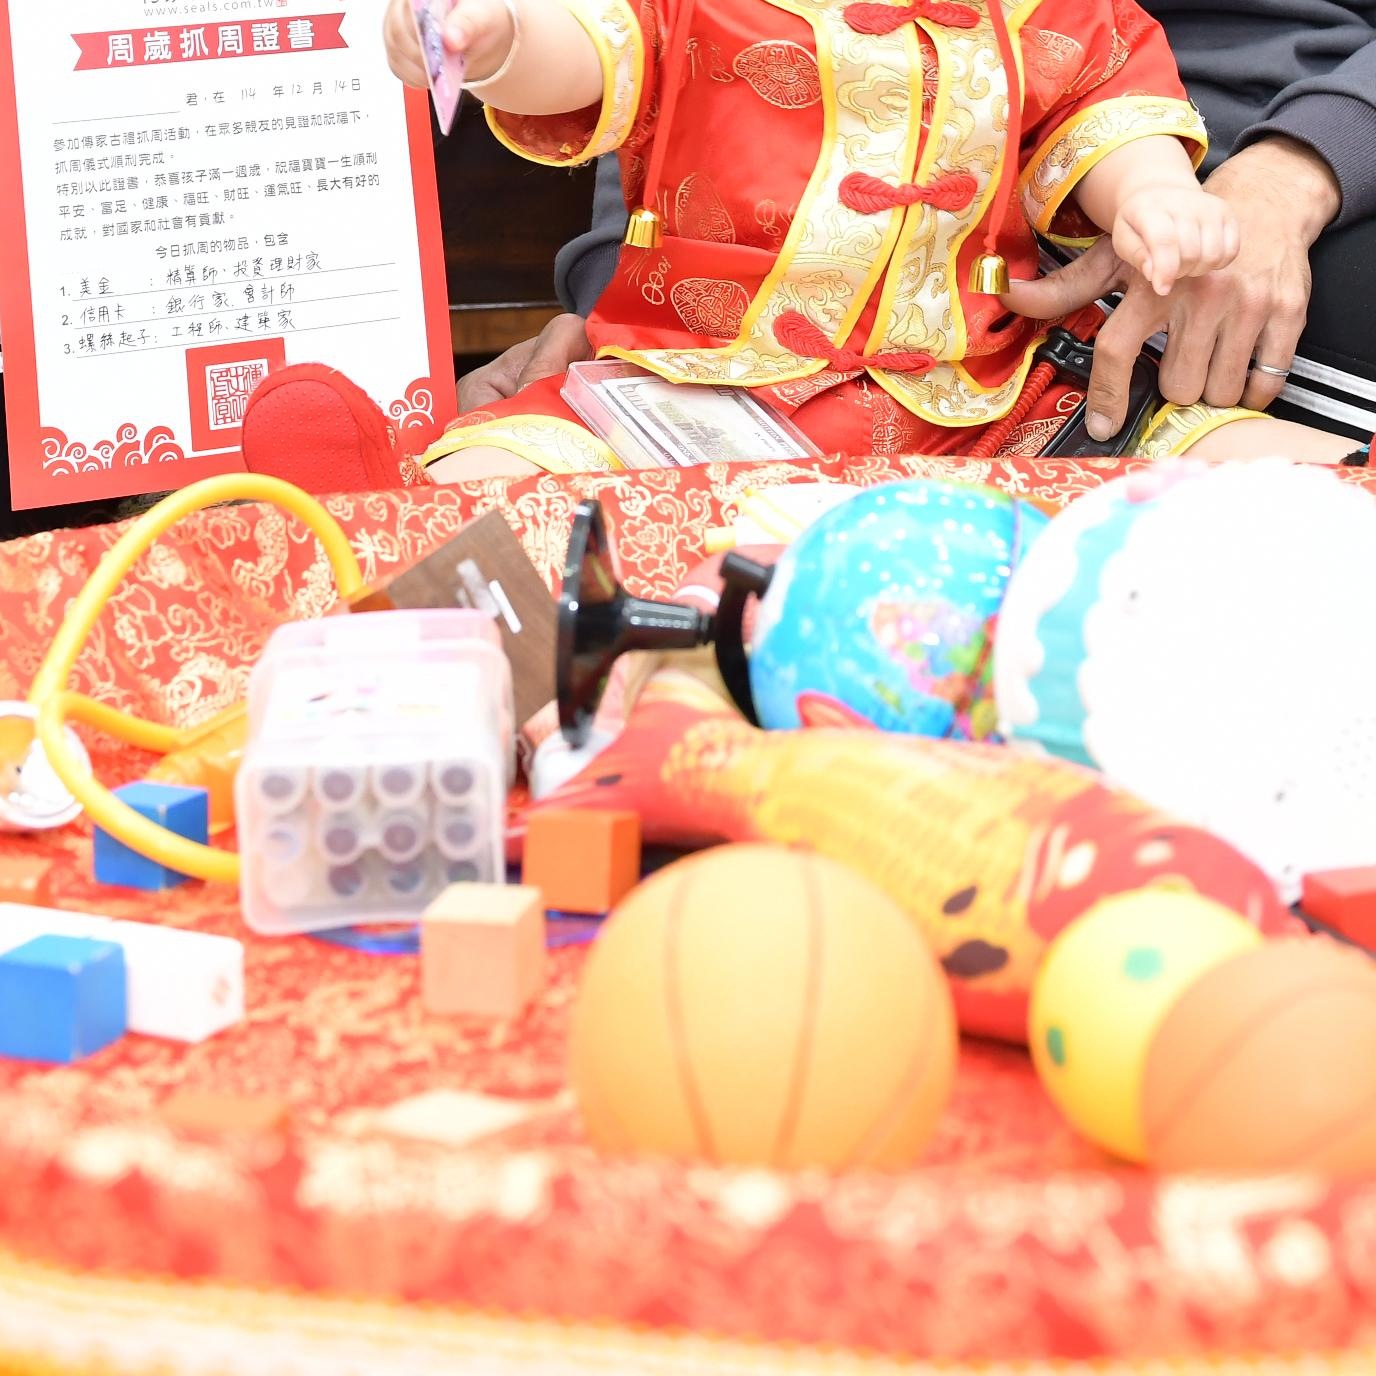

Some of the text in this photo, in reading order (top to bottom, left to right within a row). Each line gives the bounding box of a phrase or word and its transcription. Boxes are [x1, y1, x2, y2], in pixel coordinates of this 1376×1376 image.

[143, 0, 274, 17] www.seals.com.tw
[106, 18, 316, 65] 周歲抓周證書
